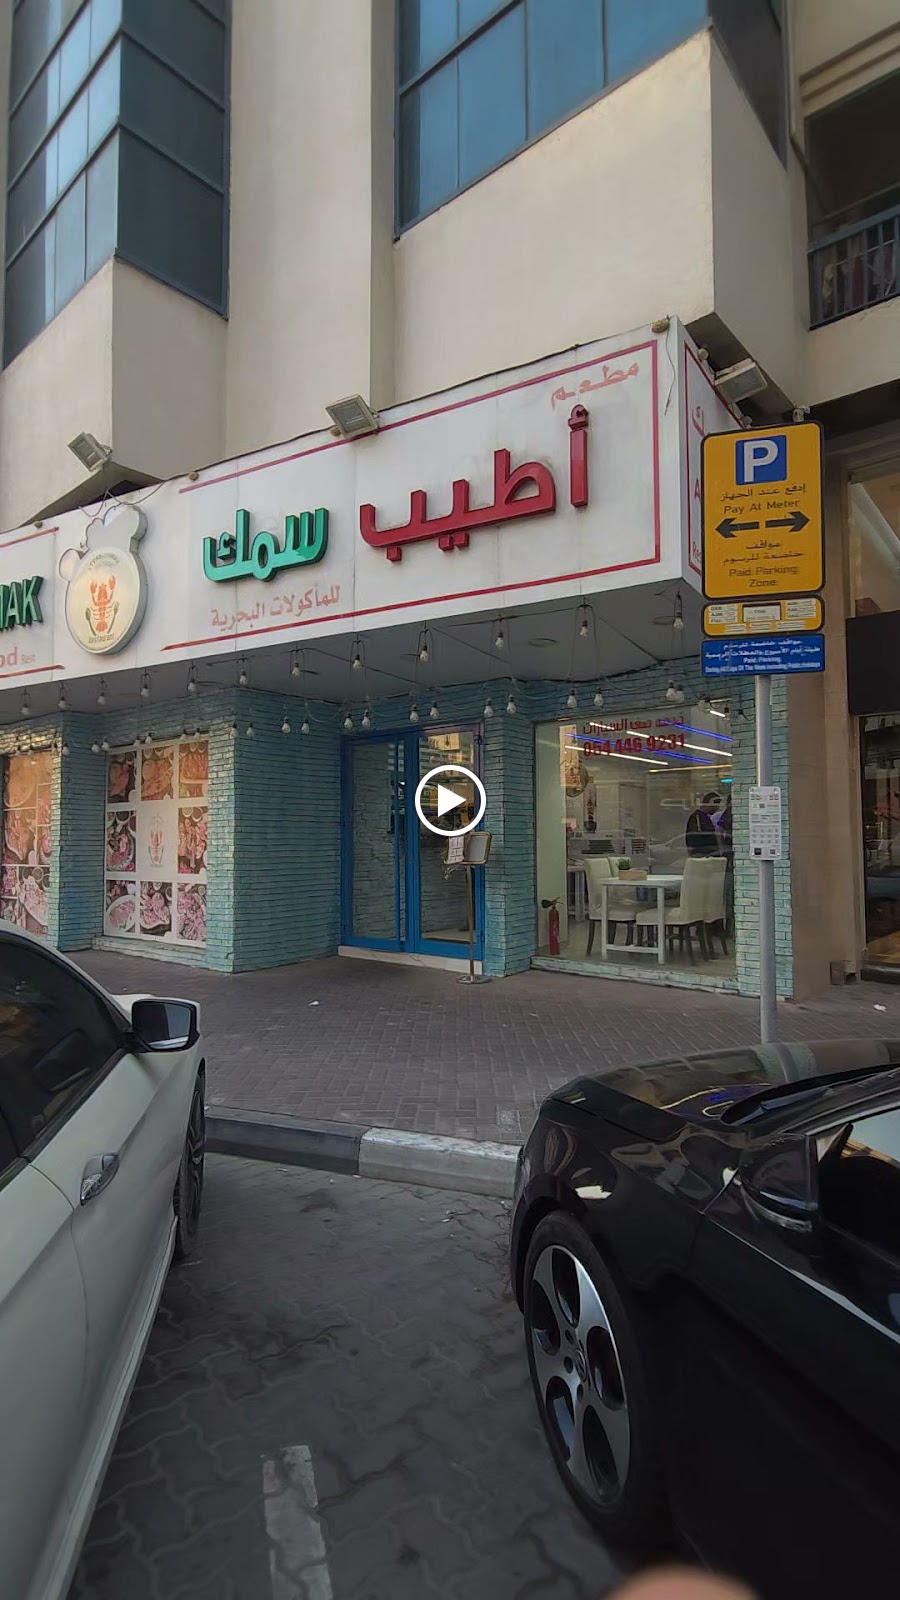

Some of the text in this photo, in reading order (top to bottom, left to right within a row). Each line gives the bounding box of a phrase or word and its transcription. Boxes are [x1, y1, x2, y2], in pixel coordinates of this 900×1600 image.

[551, 362, 640, 411] مطعم
[744, 439, 778, 483] P
[203, 404, 588, 582] أطيب سمك
[758, 487, 781, 496] عند
[723, 499, 801, 515] Pay At Meter
[728, 565, 799, 577] Paid Parking
[748, 578, 777, 588] Zone
[0, 575, 44, 632] AK
[211, 584, 341, 632] للمأكولات البحرية
[743, 655, 782, 664] Paid Parking
